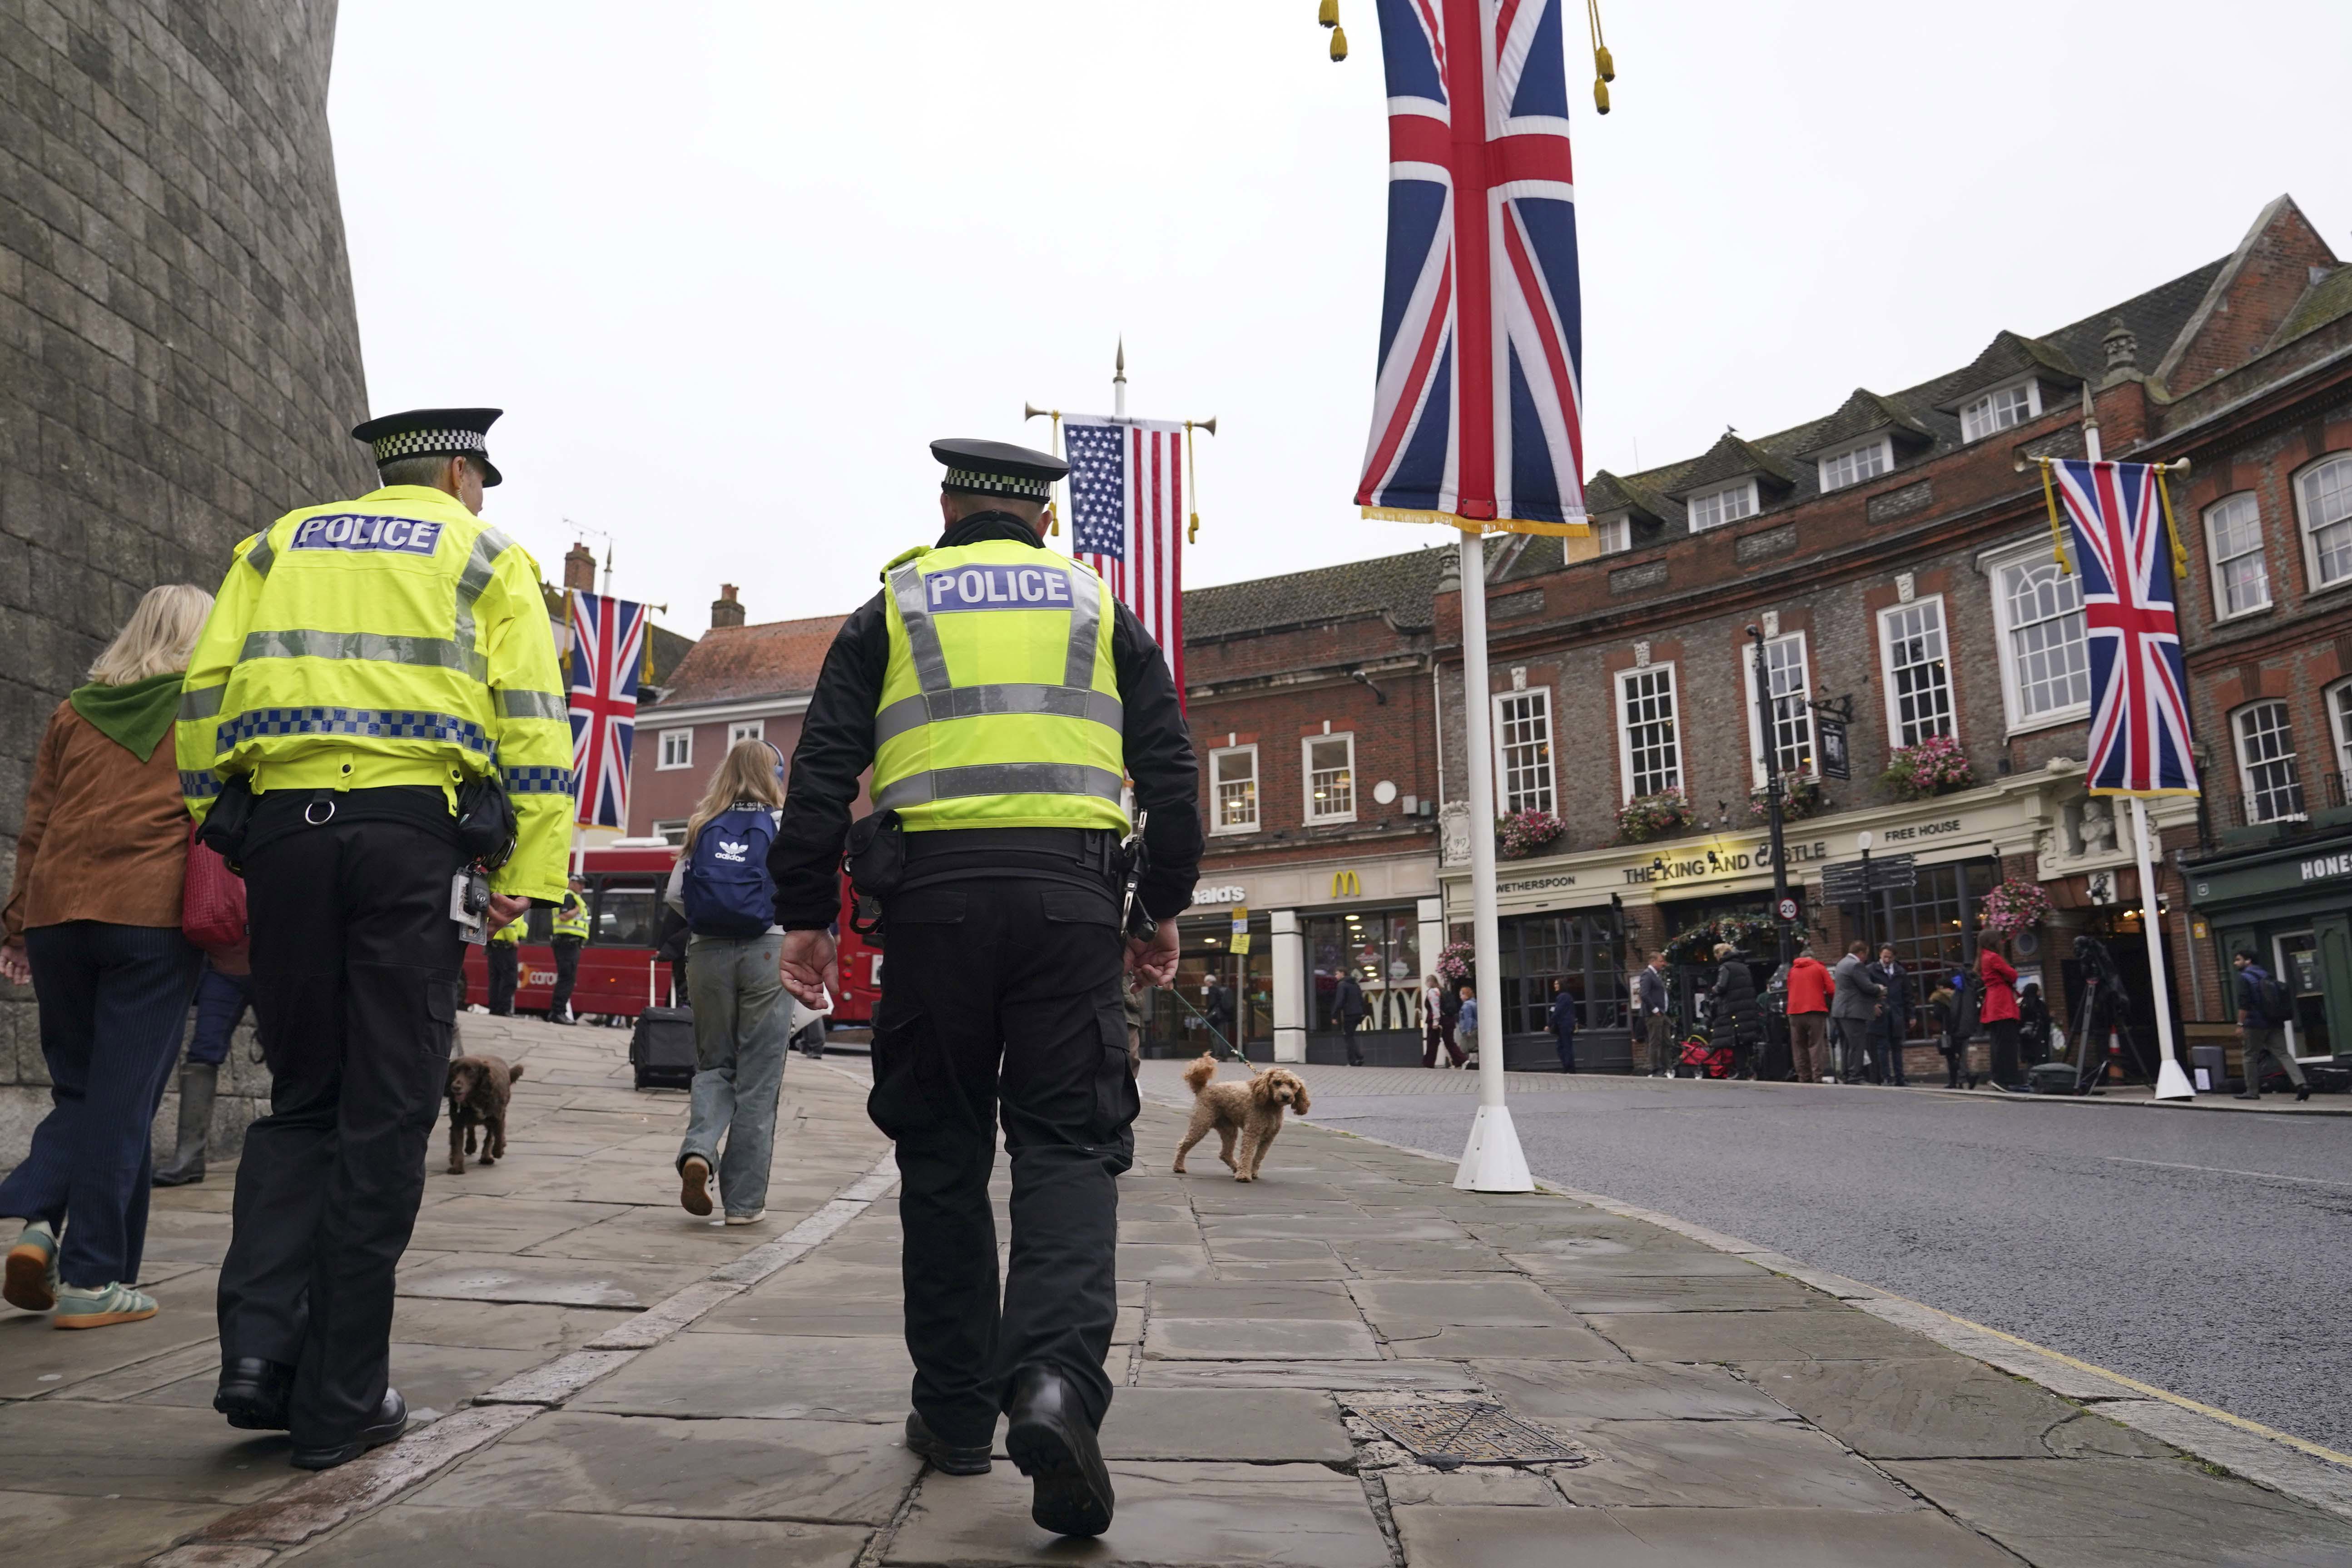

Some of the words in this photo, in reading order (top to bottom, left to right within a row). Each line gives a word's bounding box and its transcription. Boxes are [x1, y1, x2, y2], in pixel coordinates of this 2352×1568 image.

[298, 516, 435, 548] POLICE
[931, 570, 1068, 605] POLICE
[1885, 828, 1915, 842] FREE
[1919, 820, 1960, 836] HOUSE
[715, 852, 745, 862] adidas
[1623, 866, 1656, 884] THE
[1663, 860, 1705, 880] KING
[1712, 854, 1750, 873] AND
[1756, 842, 1826, 867] CSTLE
[1496, 876, 1575, 893] WETHERSPOON
[1781, 904, 1795, 913] 20
[530, 971, 559, 986] caro
